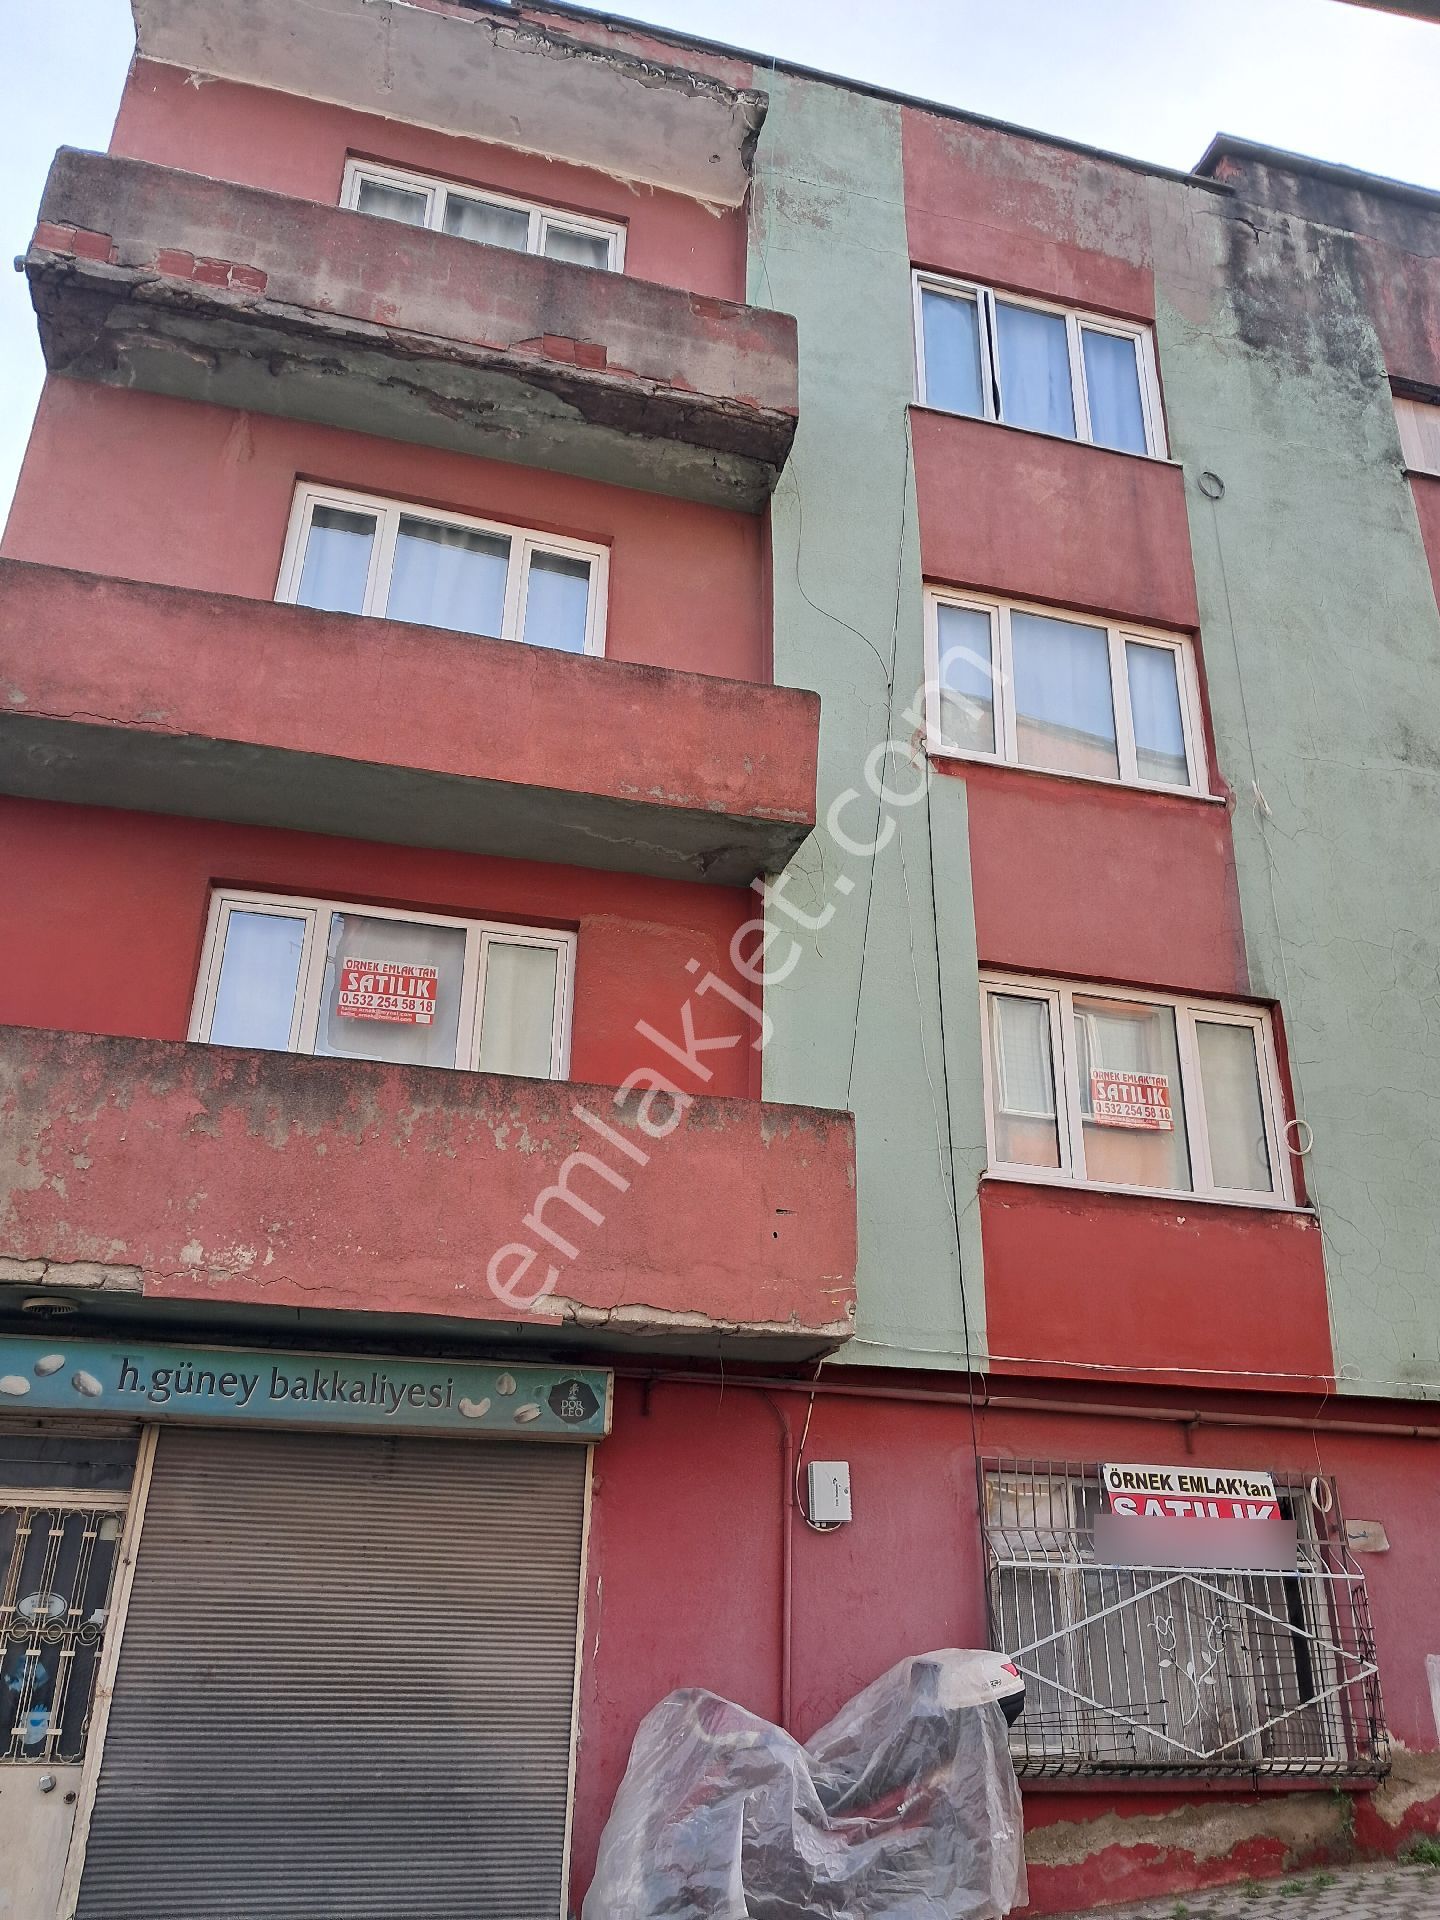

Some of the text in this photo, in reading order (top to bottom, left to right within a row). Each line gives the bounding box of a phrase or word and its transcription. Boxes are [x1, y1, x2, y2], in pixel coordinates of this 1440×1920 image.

[382, 964, 436, 978] EMLAK'TAN
[347, 972, 430, 998] SATILIK
[341, 992, 433, 1013] 0.532 254 58 18
[1096, 1082, 1166, 1106] SATILIK
[1095, 1101, 1123, 1115] 0.532
[1124, 1104, 1143, 1117] 254
[1144, 1106, 1157, 1118] 58
[1159, 1108, 1171, 1120] 18
[117, 1357, 453, 1415] h.güney bakkaliyesi
[561, 1400, 584, 1409] DOR
[561, 1407, 584, 1417] LEO
[1109, 1467, 1272, 1497] ÖRNEK EMLAK'tan
